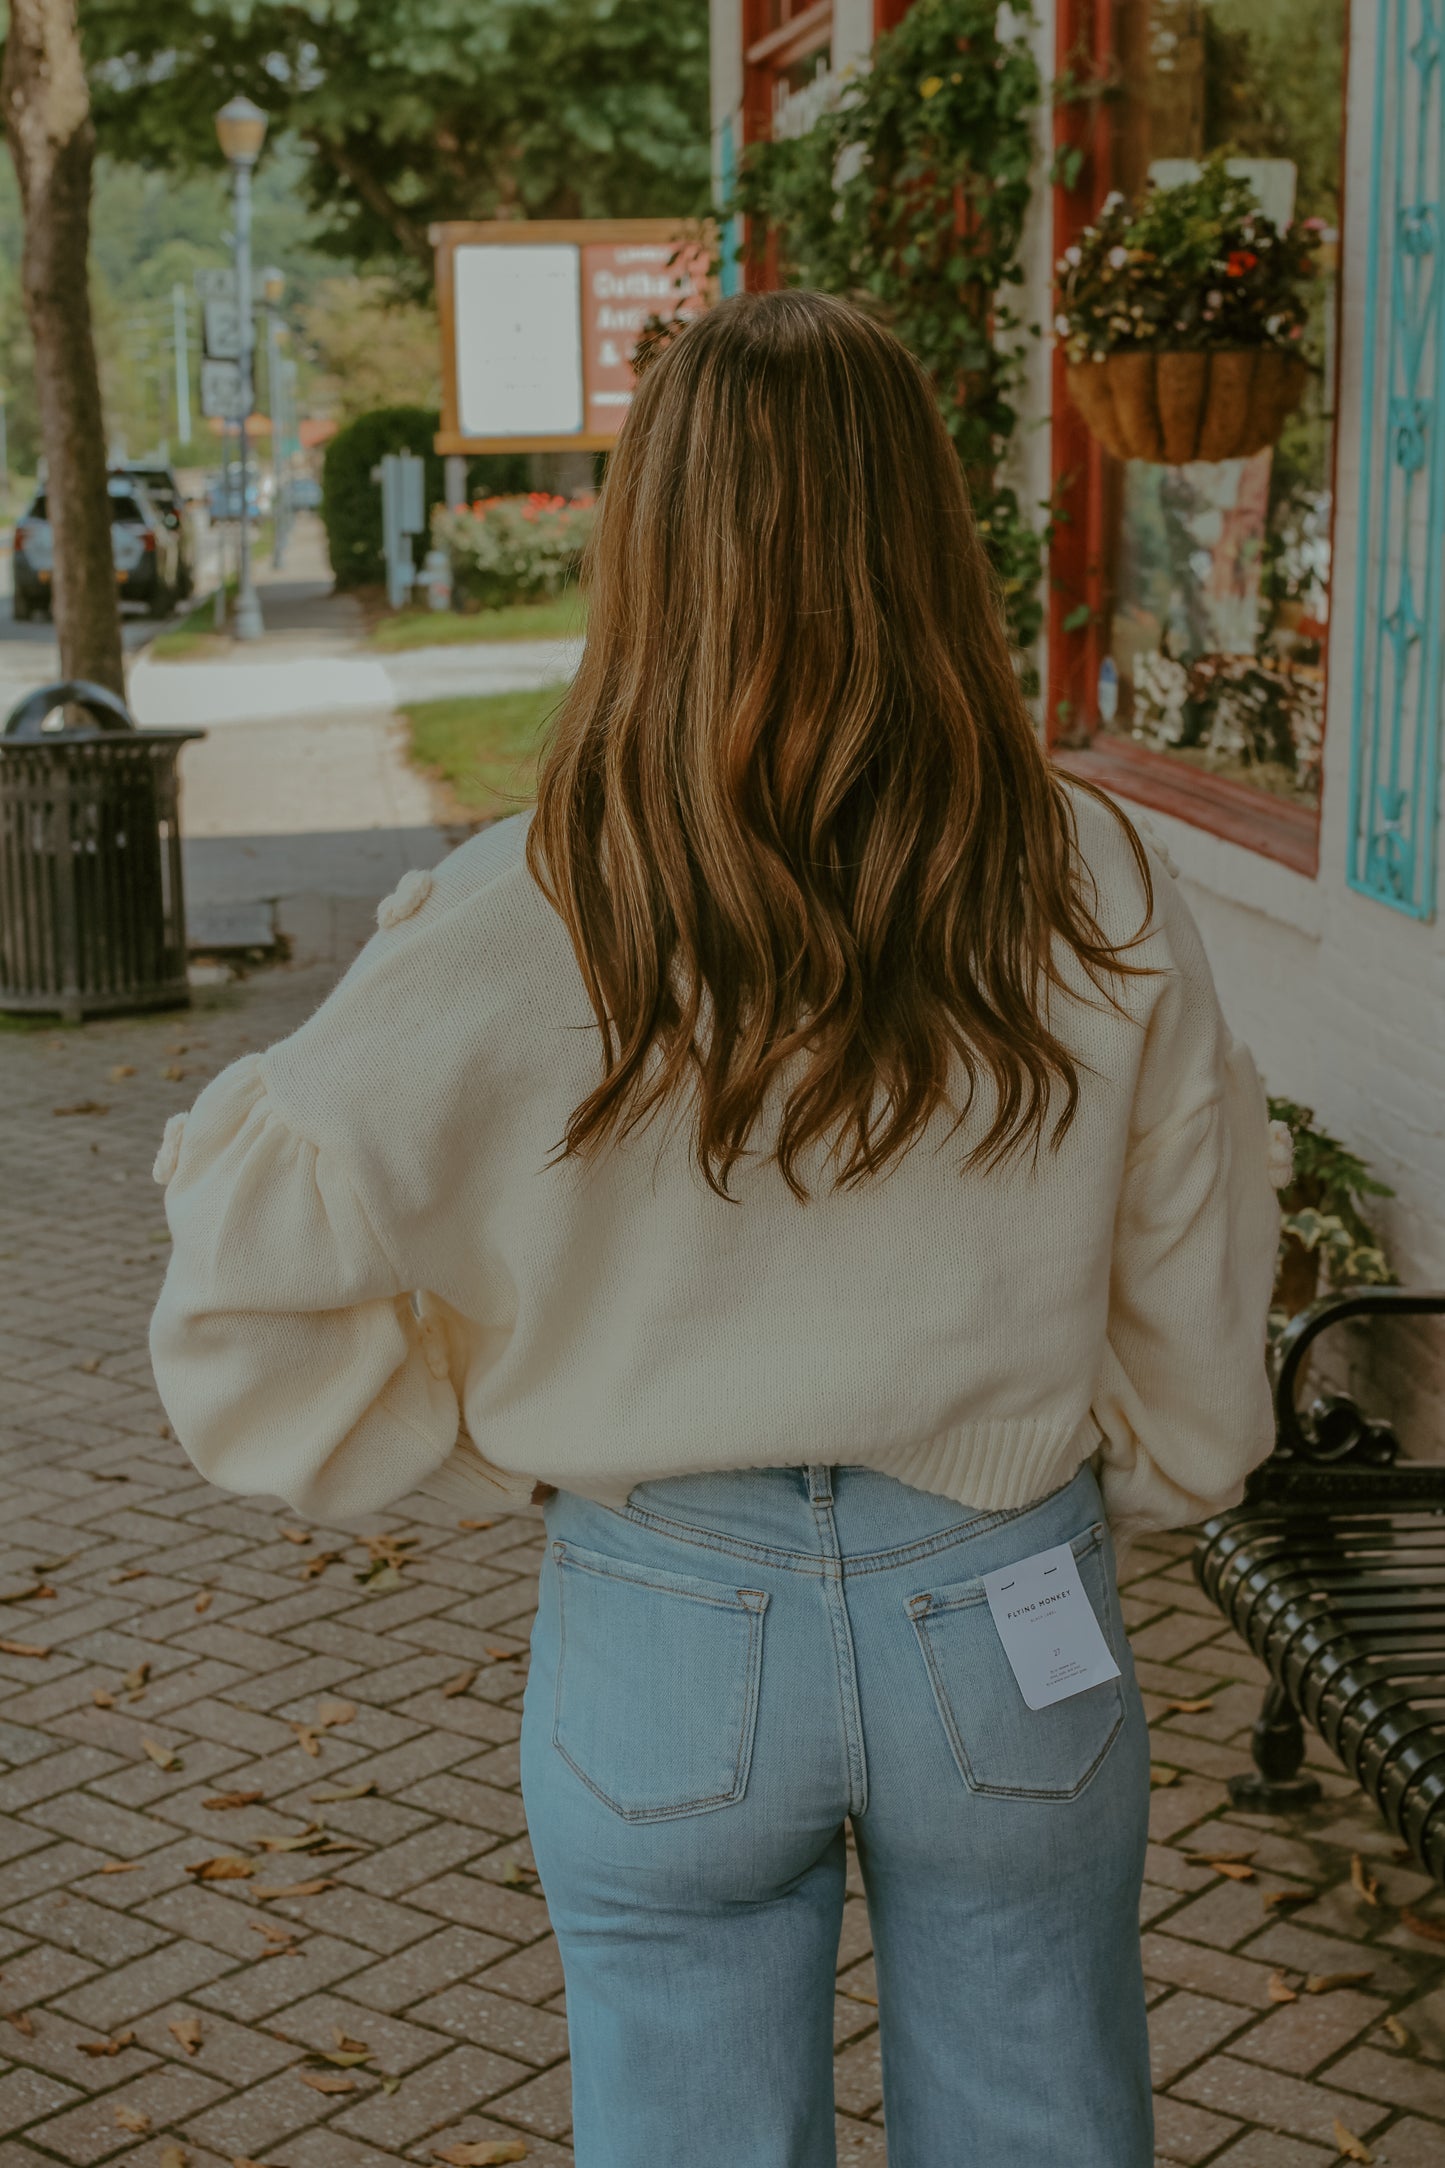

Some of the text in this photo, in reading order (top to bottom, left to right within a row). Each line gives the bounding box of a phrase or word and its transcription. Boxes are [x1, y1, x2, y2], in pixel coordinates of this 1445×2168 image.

[1007, 1590, 1071, 1619] FLYING MONKEY
[1053, 1647, 1061, 1657] 27
